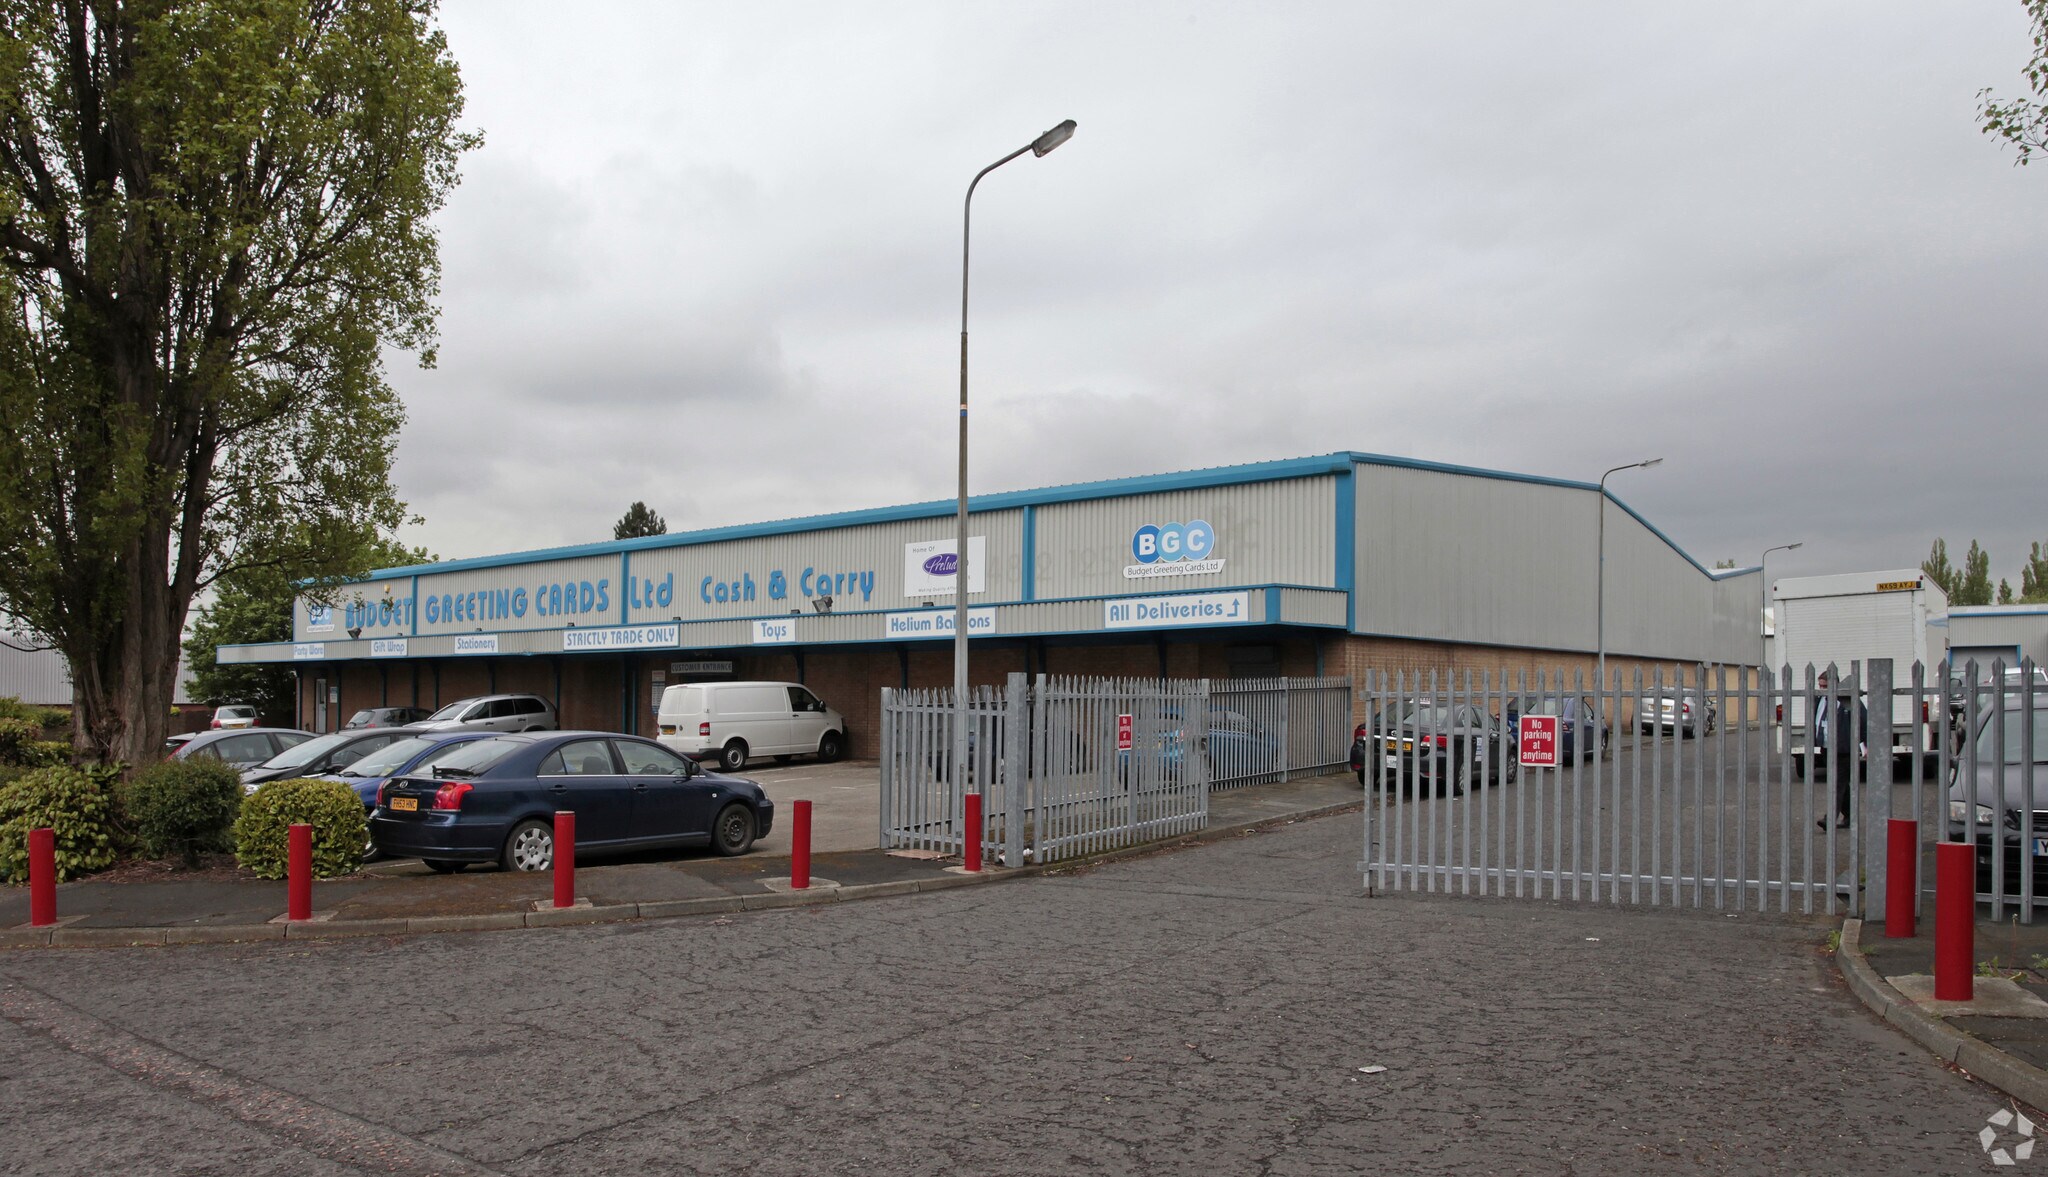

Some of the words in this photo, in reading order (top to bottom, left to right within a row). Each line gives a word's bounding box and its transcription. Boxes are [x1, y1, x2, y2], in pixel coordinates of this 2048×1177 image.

[1138, 529, 1205, 556] BGC
[925, 554, 958, 573] Prelud
[1127, 566, 1152, 576] Budget
[1154, 563, 1184, 574] Greeting
[1185, 562, 1206, 572] Cards
[1206, 561, 1218, 570] Ltd
[345, 597, 413, 629] BUDGET
[425, 587, 528, 624] GREETING
[536, 579, 609, 616] CARDS
[630, 572, 673, 609] Ltd
[701, 572, 756, 603] Cash
[768, 570, 787, 600] &
[800, 567, 874, 601] Carry
[1110, 604, 1130, 621] All
[1136, 600, 1223, 620] Deliveries
[891, 617, 931, 632] Helium
[936, 615, 991, 630] Balons
[567, 632, 608, 646] STRICTLY
[610, 630, 643, 644] TRADE
[646, 628, 675, 643] ONLY
[761, 622, 787, 641] Toys
[294, 646, 308, 658] Party
[374, 642, 386, 653] Gift
[387, 641, 404, 654] Wrap
[457, 637, 495, 652] Stationery
[672, 663, 700, 672] CUSTOMER
[702, 661, 732, 671] ENTRANCE
[1532, 719, 1542, 728] No
[1524, 730, 1552, 741] parking
[1533, 741, 1540, 749] at
[1523, 751, 1552, 761] anytime
